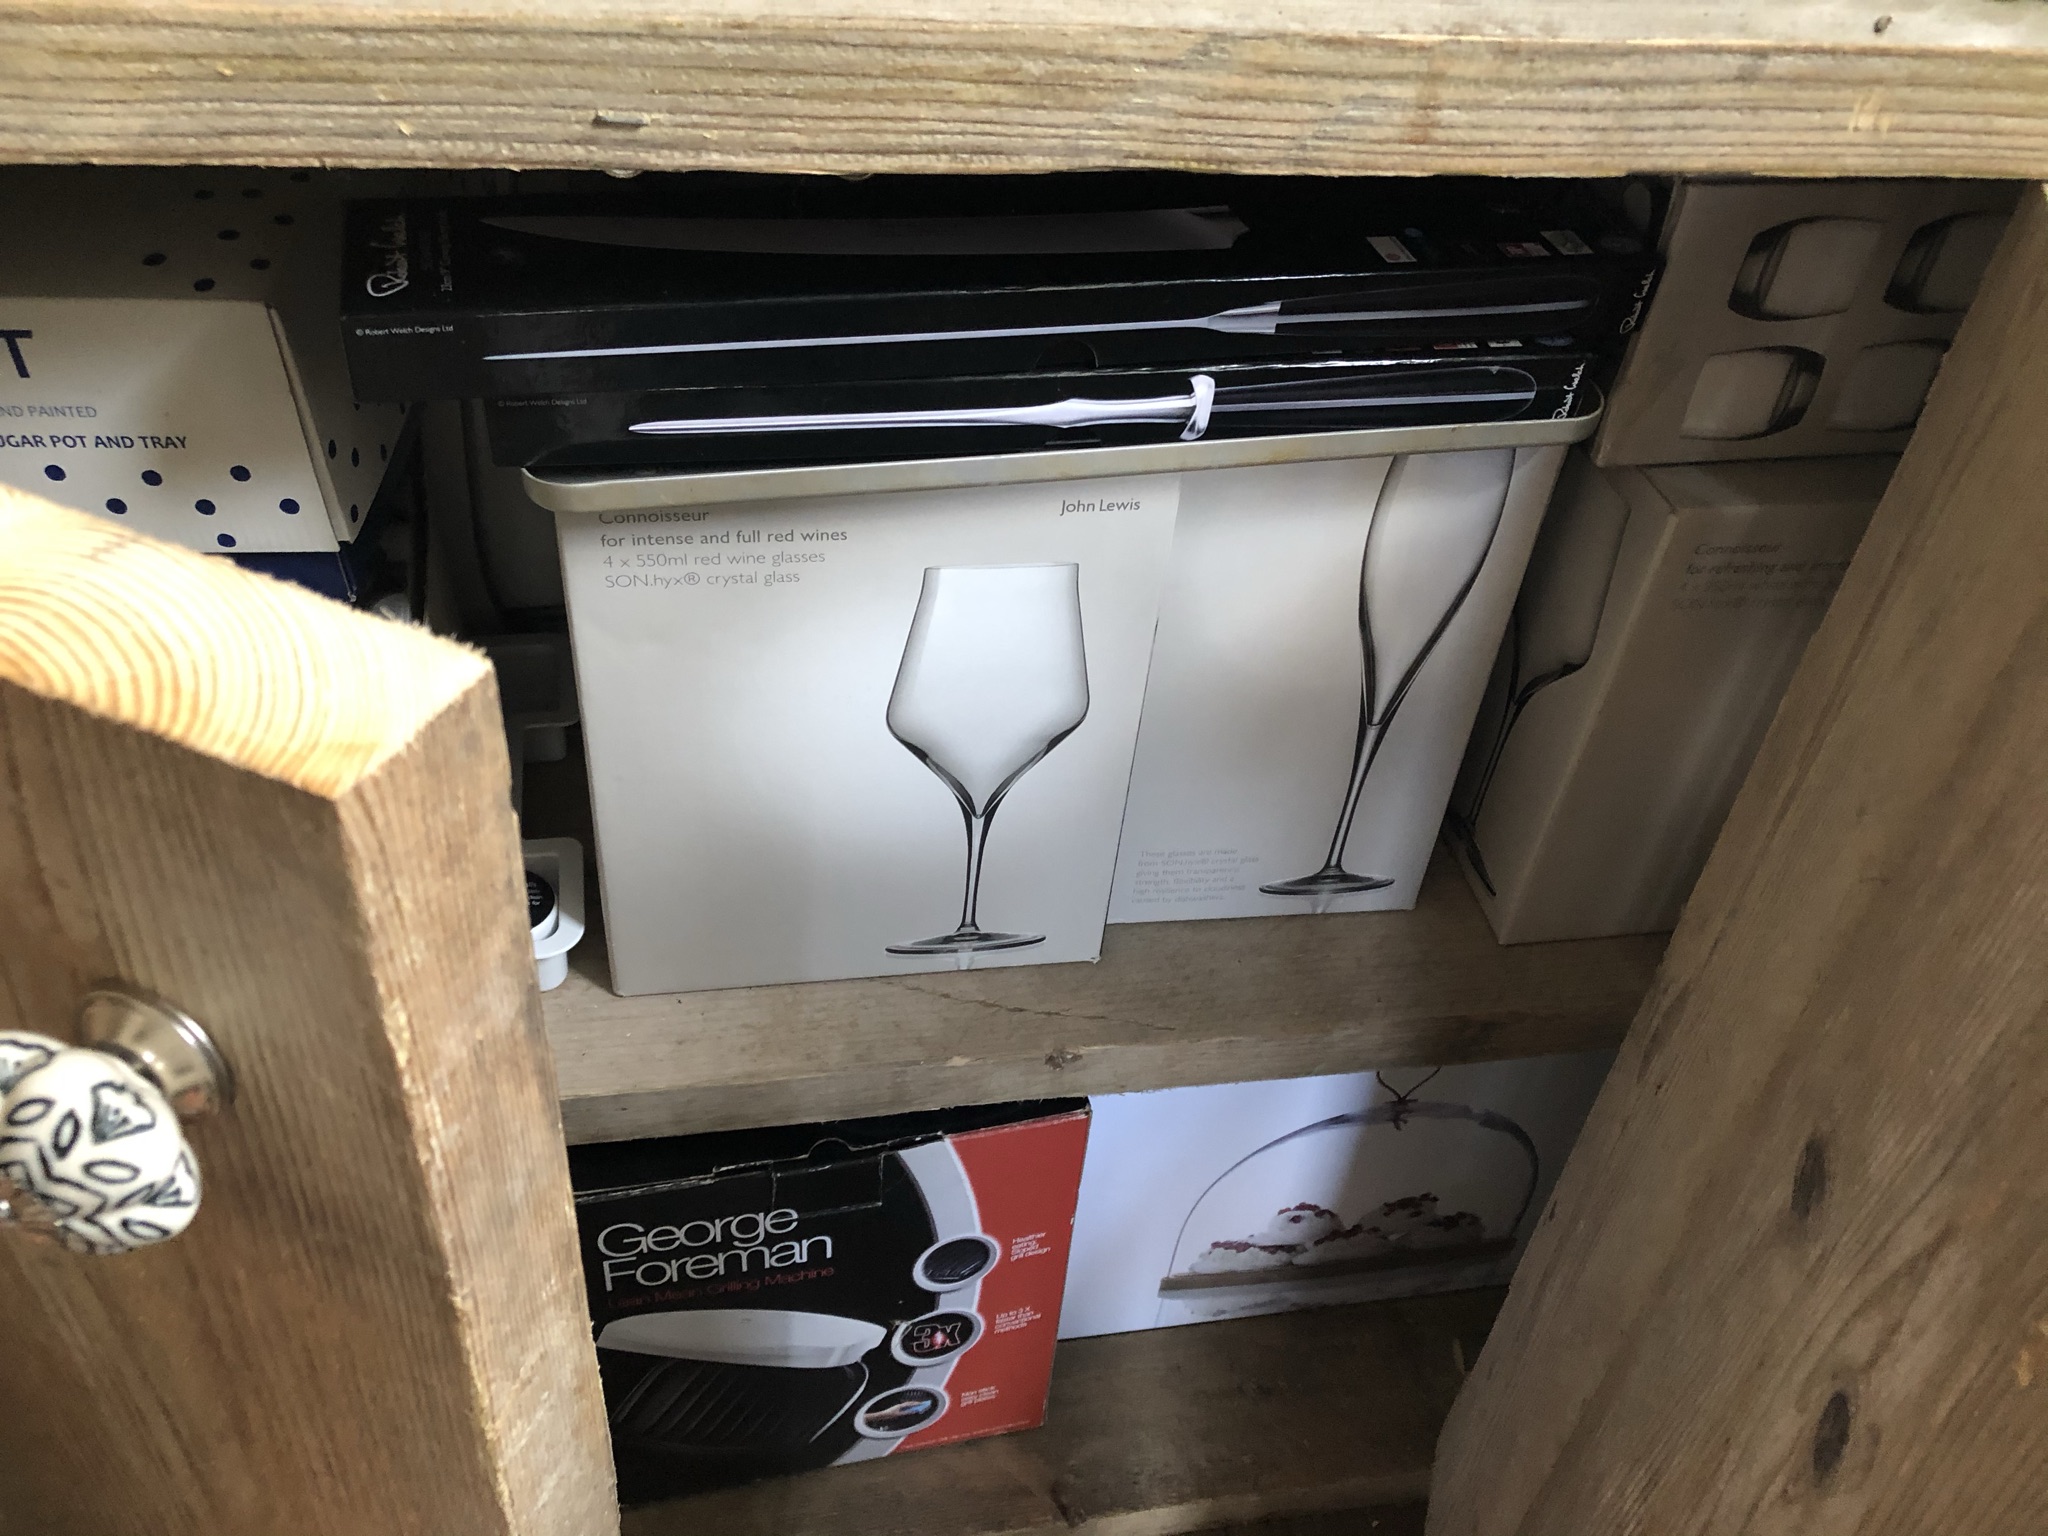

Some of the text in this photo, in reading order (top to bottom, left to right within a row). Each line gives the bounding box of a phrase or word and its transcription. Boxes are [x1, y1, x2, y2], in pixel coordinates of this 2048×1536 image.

[364, 327, 390, 337] Robert
[390, 326, 414, 336] Welch
[414, 325, 441, 335] Designs
[441, 323, 454, 333] Ltd
[27, 405, 98, 419] PAINTED
[49, 434, 88, 449] POT
[94, 435, 135, 450] AND
[138, 435, 188, 450] TRAY
[598, 509, 711, 525] Connoisseur
[1059, 497, 1141, 517] John Lewis
[600, 528, 849, 548] for intense and full red wines
[602, 550, 827, 569] 4 x 550ml red wine glasses
[604, 569, 802, 590] SON.hyx® crystal glass
[596, 1207, 800, 1259] George
[602, 1234, 834, 1293] Foreman
[706, 1278, 762, 1295] Grilling
[763, 1264, 836, 1288] Machine
